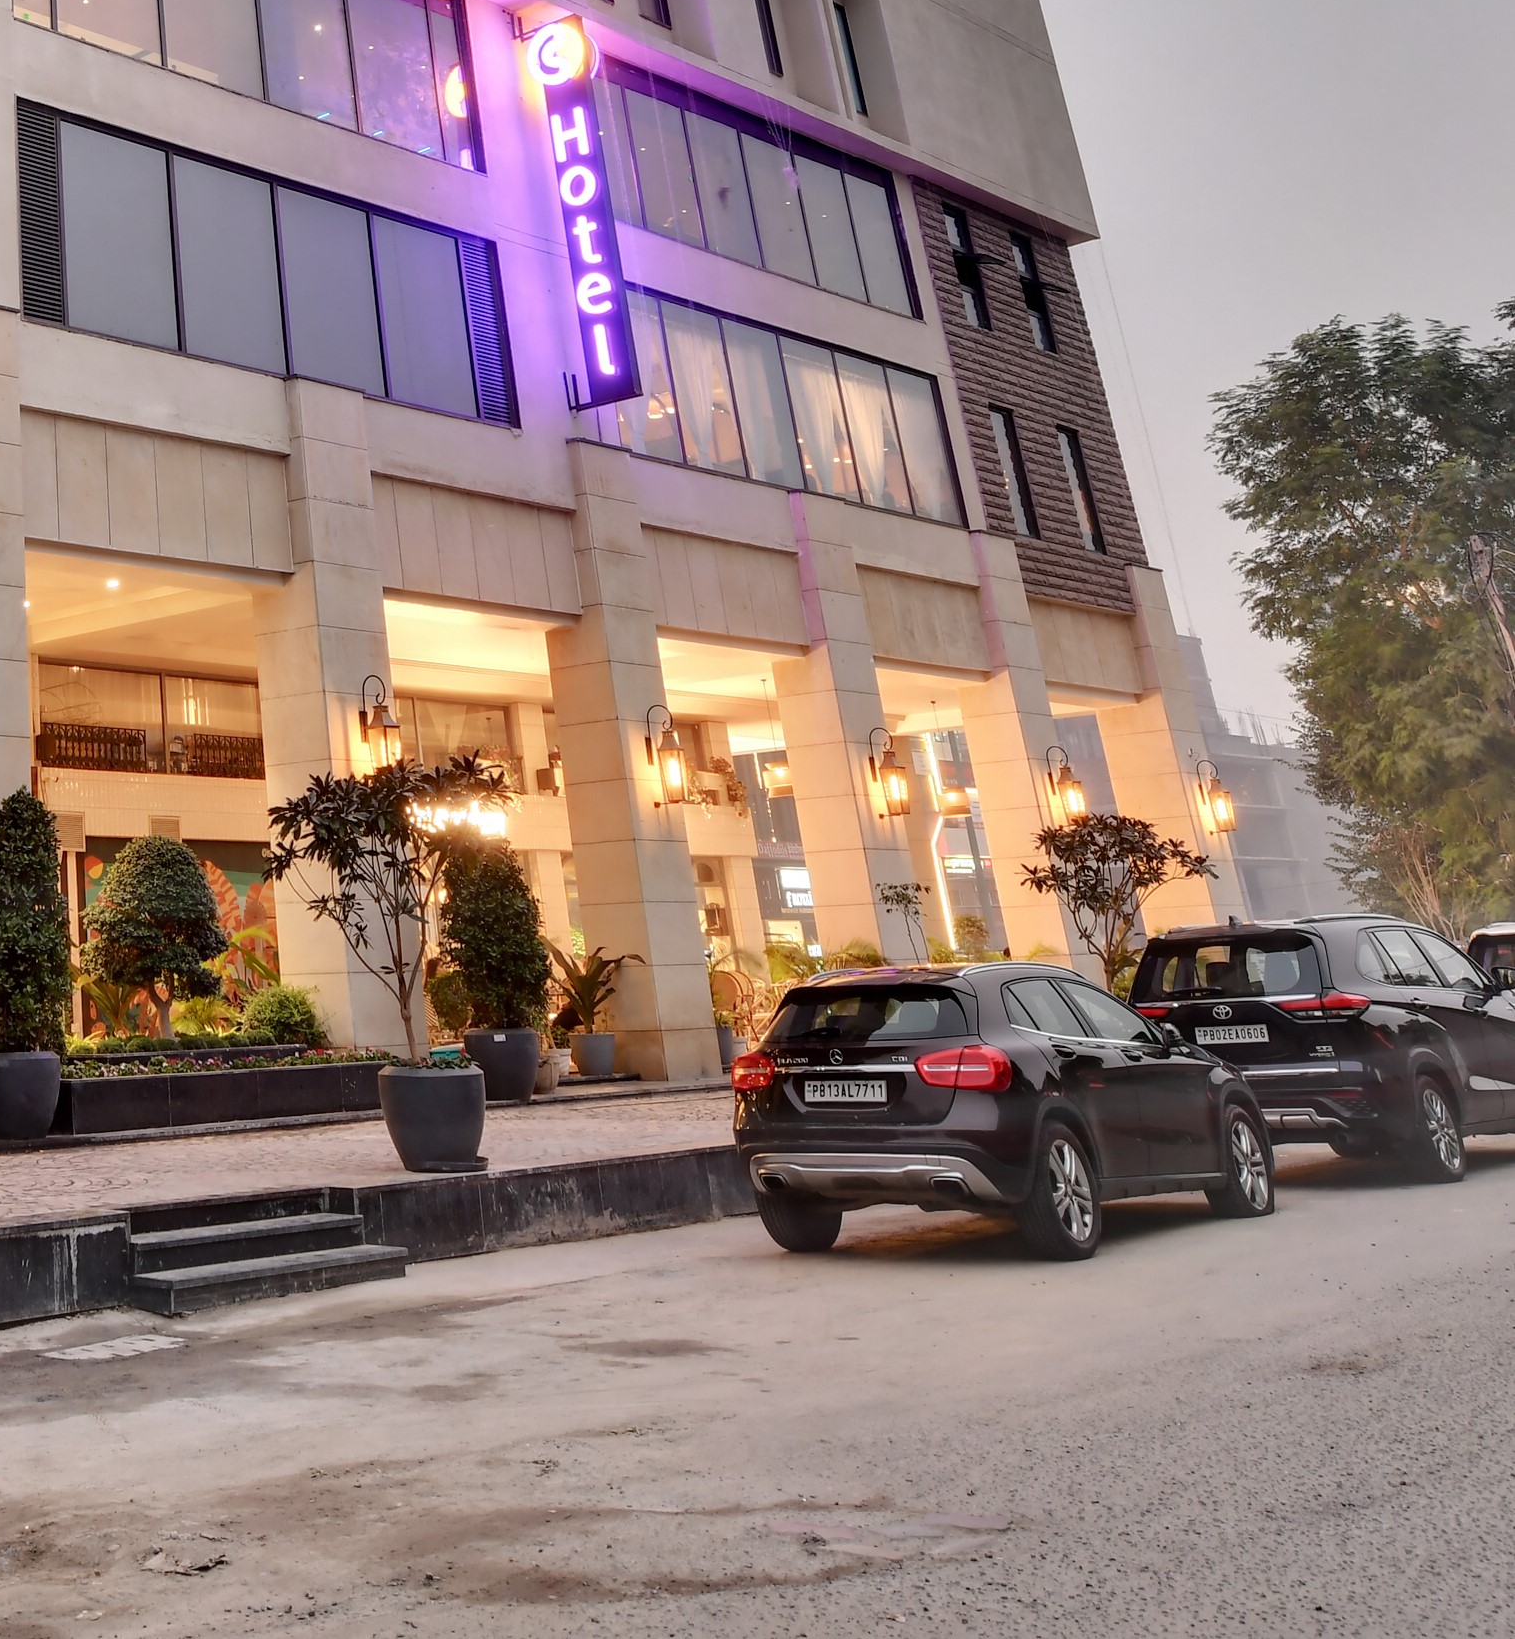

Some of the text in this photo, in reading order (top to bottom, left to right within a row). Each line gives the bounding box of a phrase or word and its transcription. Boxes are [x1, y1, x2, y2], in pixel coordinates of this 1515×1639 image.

[549, 105, 616, 377] Hotel
[1202, 1027, 1266, 1041] PB02EA0606
[812, 1084, 884, 1098] PB13AL7711
